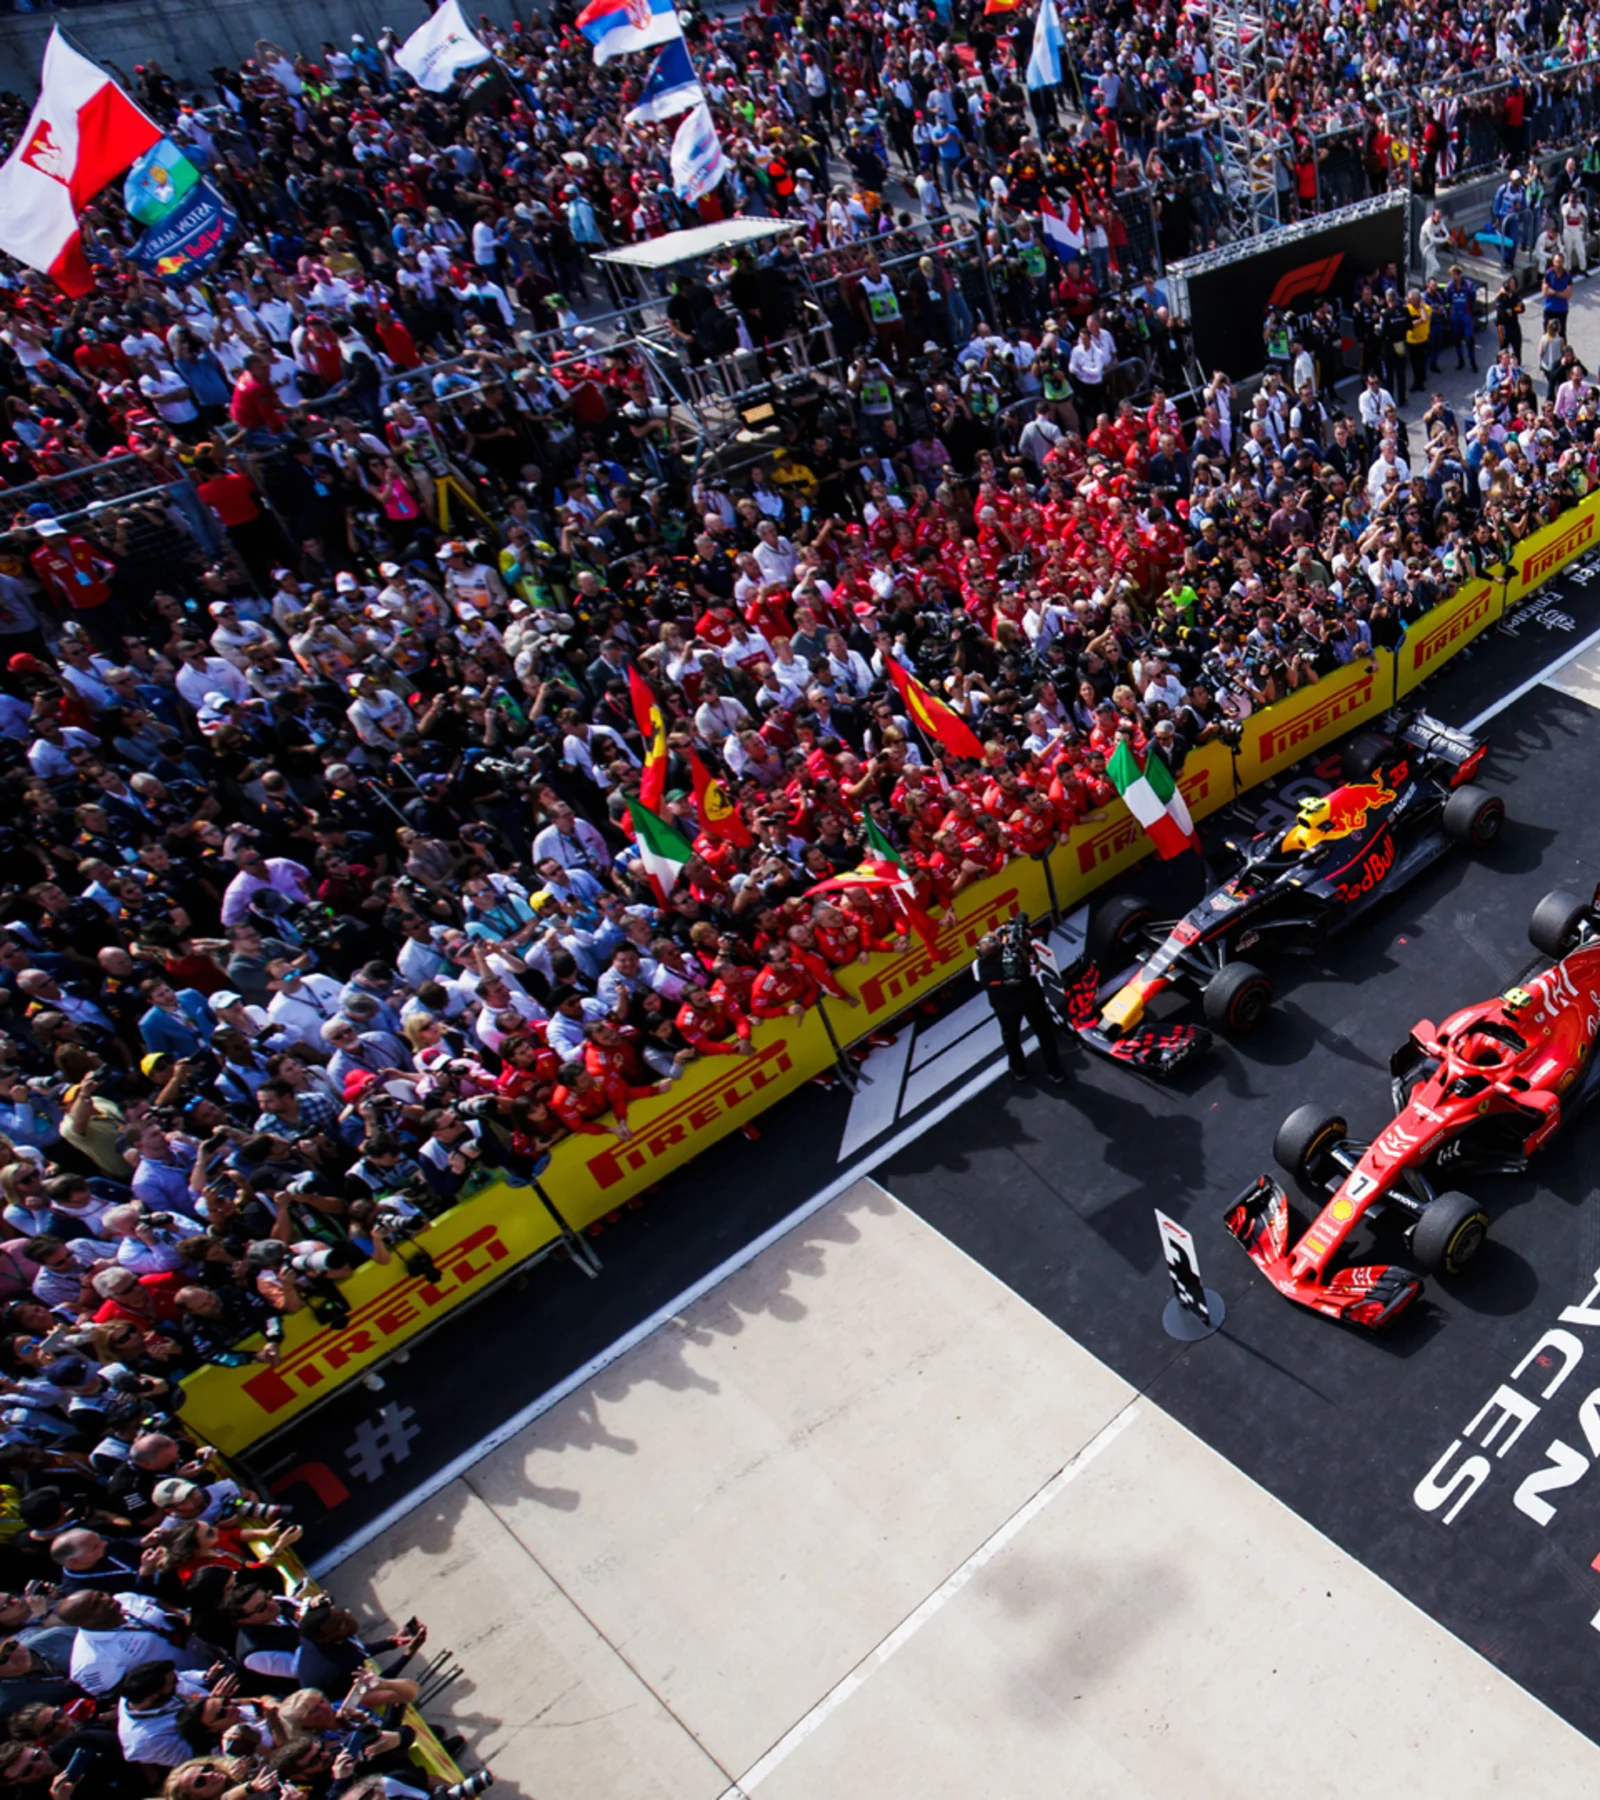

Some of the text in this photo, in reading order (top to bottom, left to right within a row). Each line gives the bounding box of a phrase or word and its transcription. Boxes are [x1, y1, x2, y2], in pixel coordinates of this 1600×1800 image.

[1522, 513, 1595, 586] PIRELLI
[1413, 586, 1492, 670] PIRELLI
[1259, 674, 1374, 764] PIRELLI
[1389, 760, 1409, 788] 33
[586, 1039, 793, 1190] PIRELLI
[1351, 1176, 1370, 1196] 7
[240, 1224, 510, 1414] PIRELLI
